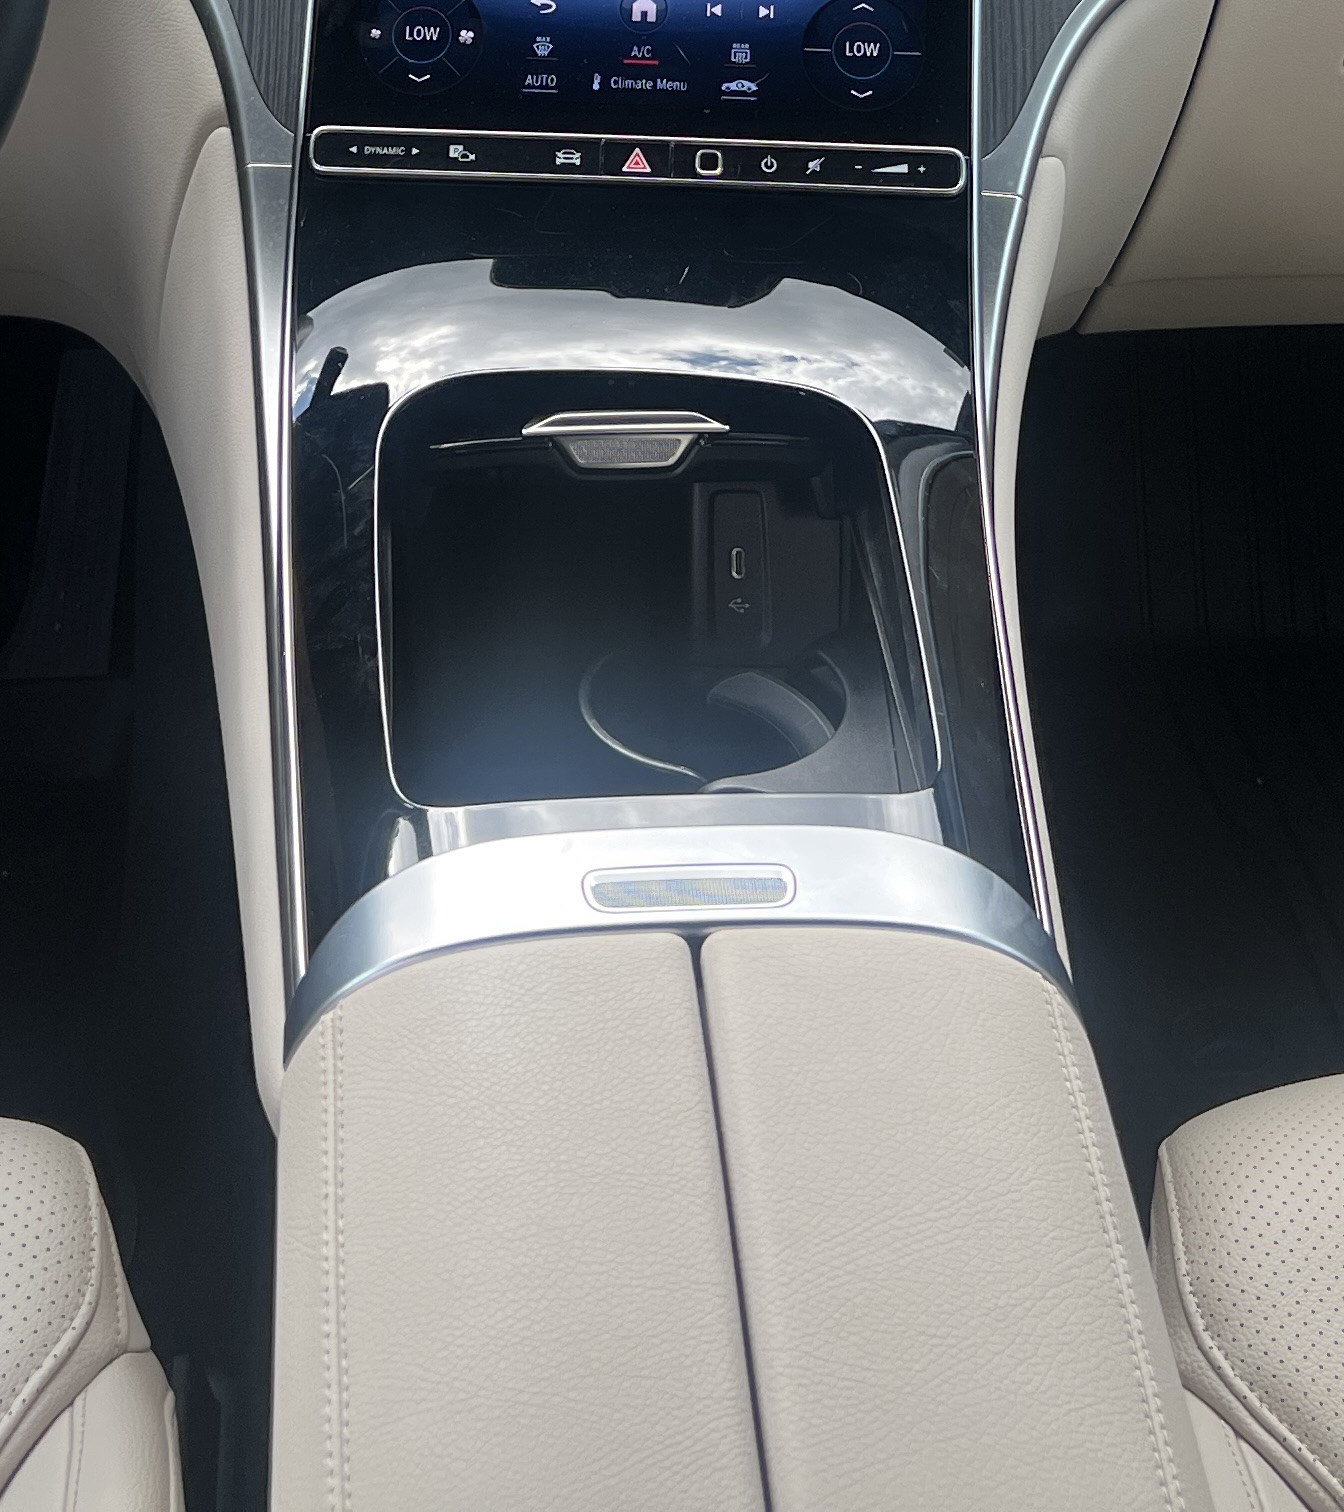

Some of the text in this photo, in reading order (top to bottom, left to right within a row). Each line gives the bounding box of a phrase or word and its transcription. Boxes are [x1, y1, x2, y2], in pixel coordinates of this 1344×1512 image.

[404, 25, 440, 41] LOW
[630, 44, 652, 58] A/C
[845, 40, 880, 57] LOW
[524, 73, 557, 87] AUTO
[610, 76, 688, 91] Climate Menu
[363, 145, 406, 156] DYNAMIC
